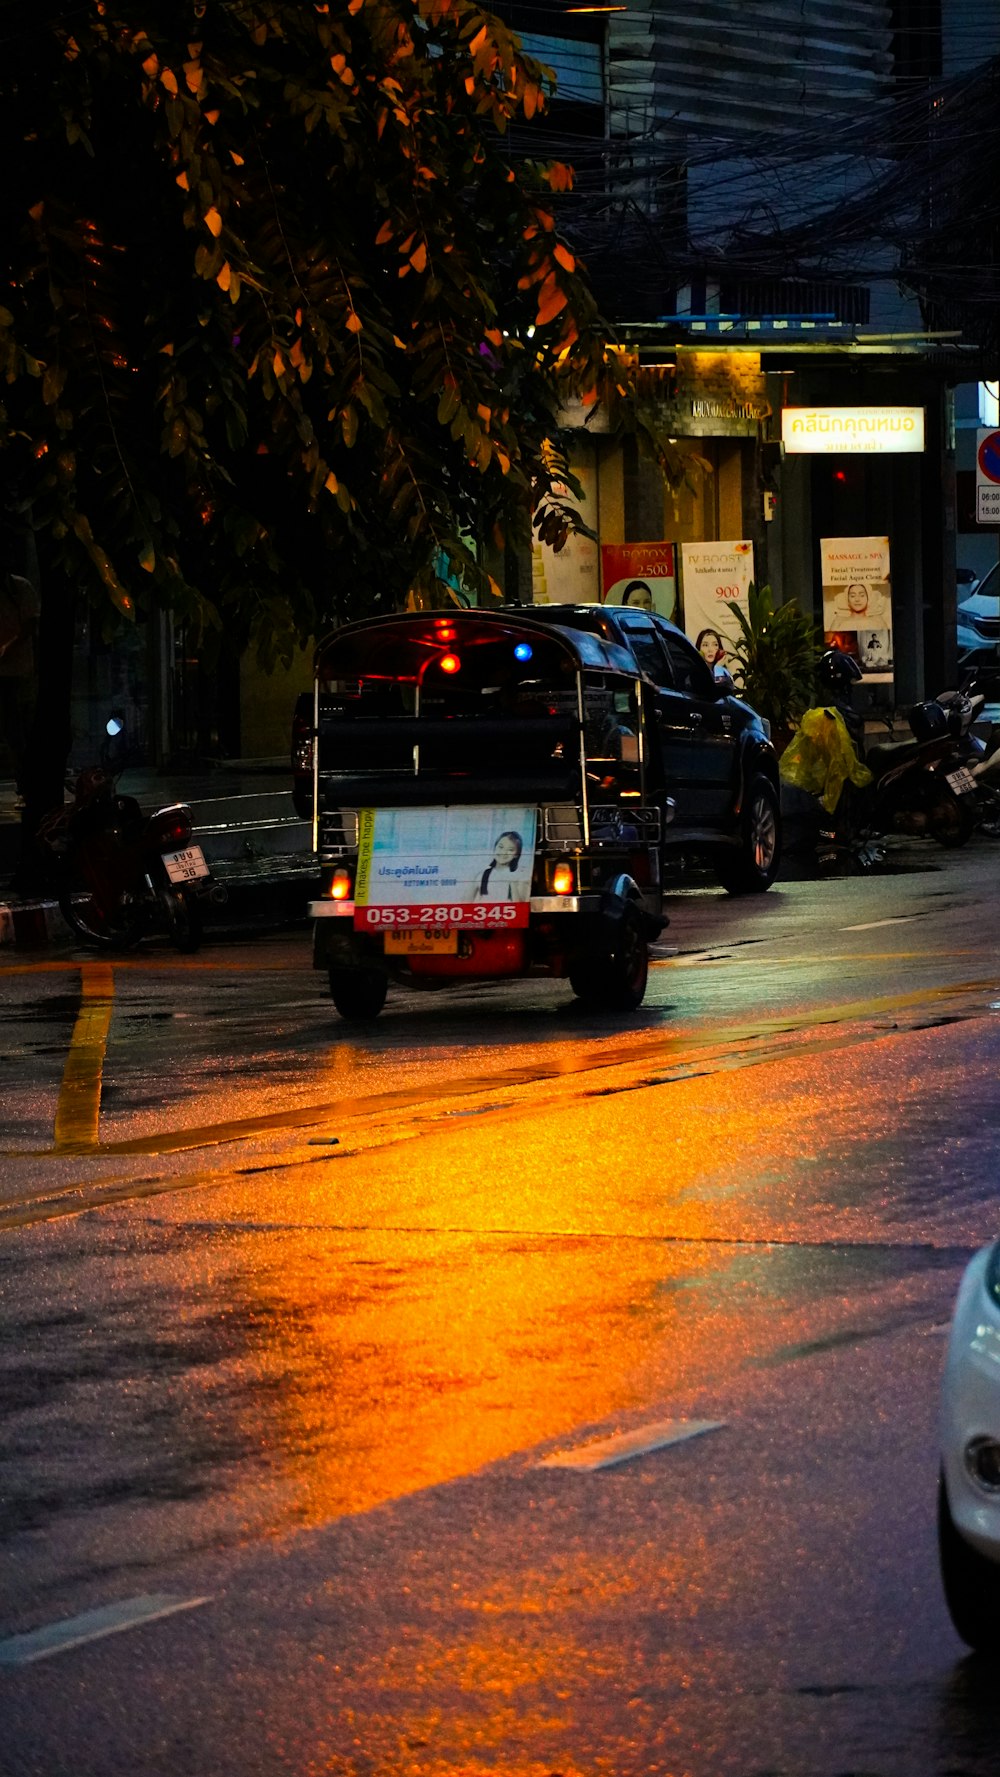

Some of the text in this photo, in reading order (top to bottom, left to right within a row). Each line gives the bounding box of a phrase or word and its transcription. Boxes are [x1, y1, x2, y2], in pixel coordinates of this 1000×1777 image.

[792, 412, 915, 438] คลีนิกคุณหมอ
[981, 493, 1000, 501] 06:00
[981, 507, 1000, 515] 15:00
[703, 553, 743, 563] BOOST
[828, 553, 863, 561] MASSAGE
[849, 574, 864, 582] Aqua
[715, 586, 740, 599] 900
[363, 809, 375, 840] happy
[363, 841, 371, 859] me
[182, 868, 196, 878] 36
[358, 859, 369, 890] makes
[378, 865, 439, 878] ประตูอัตโนมัติ
[404, 879, 439, 887] AUTOMATIC
[366, 905, 517, 924] 053-280-345
